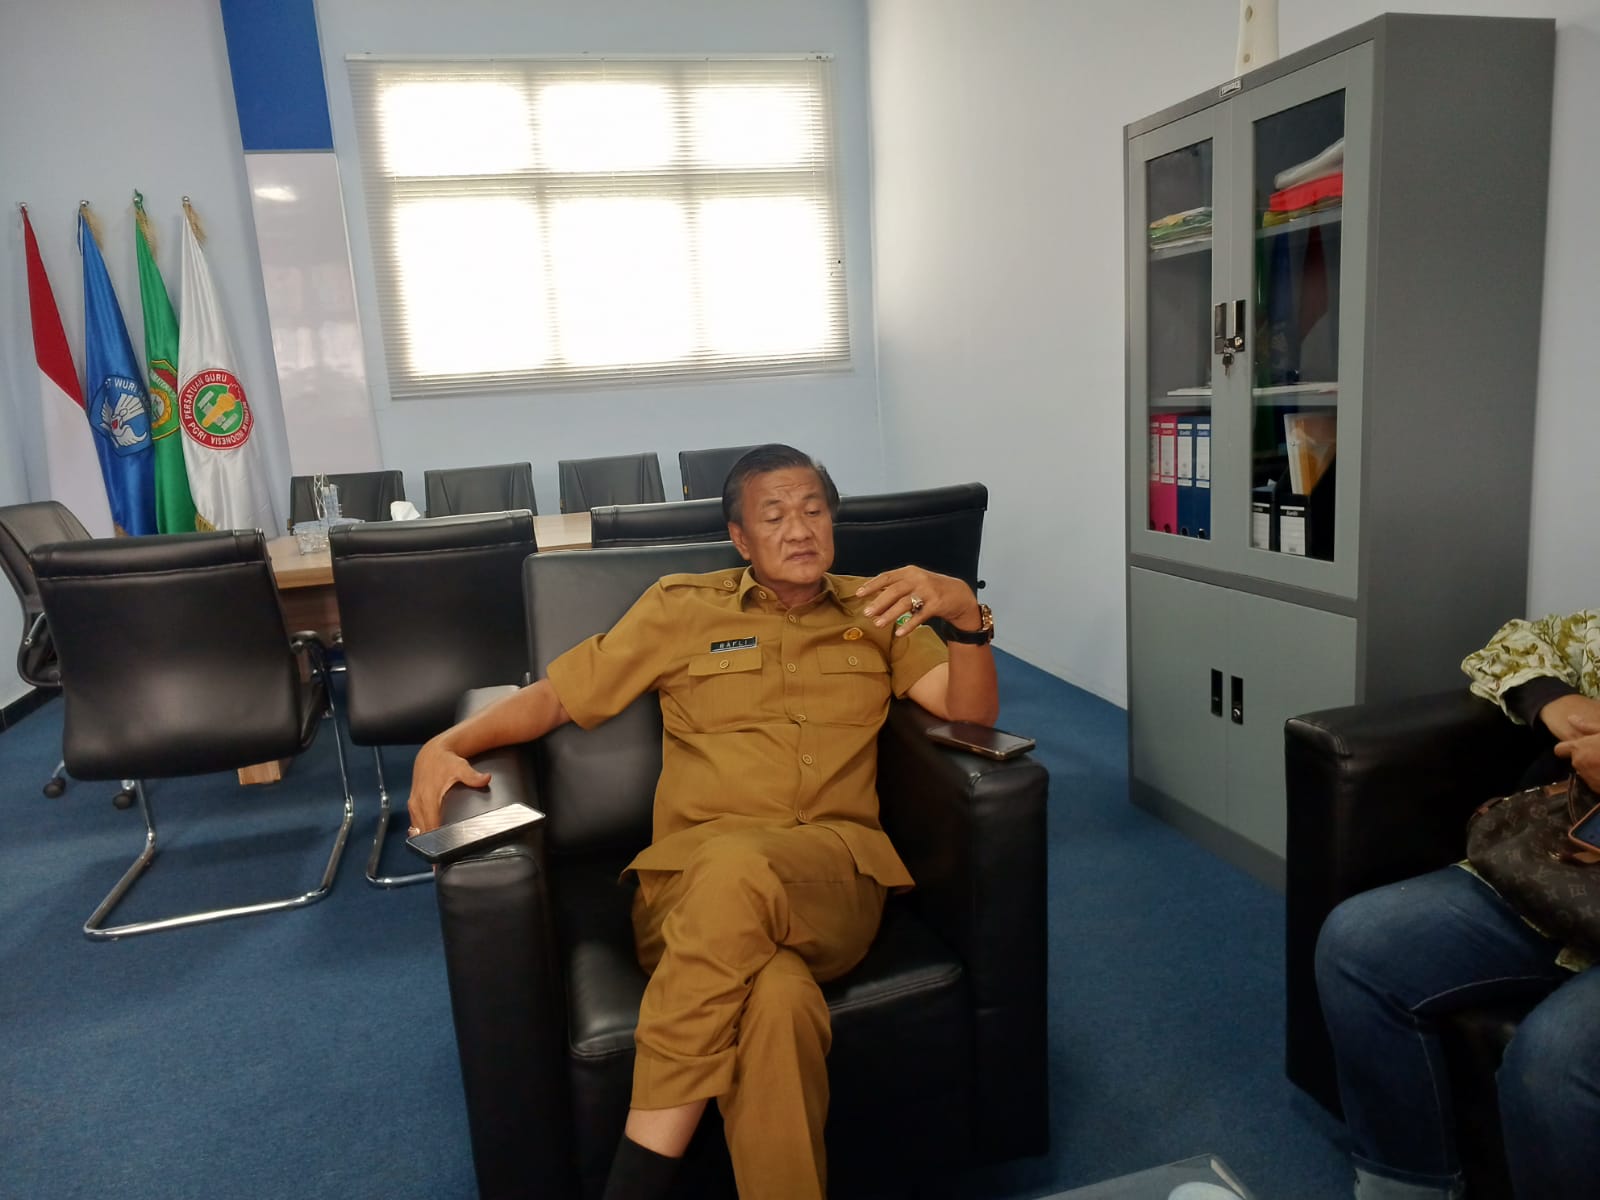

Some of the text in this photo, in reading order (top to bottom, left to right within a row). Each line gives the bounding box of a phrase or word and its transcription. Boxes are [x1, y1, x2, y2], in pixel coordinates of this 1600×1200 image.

[184, 377, 204, 419] PERSATUAN
[205, 373, 227, 382] GURU
[188, 422, 207, 441] PGRI
